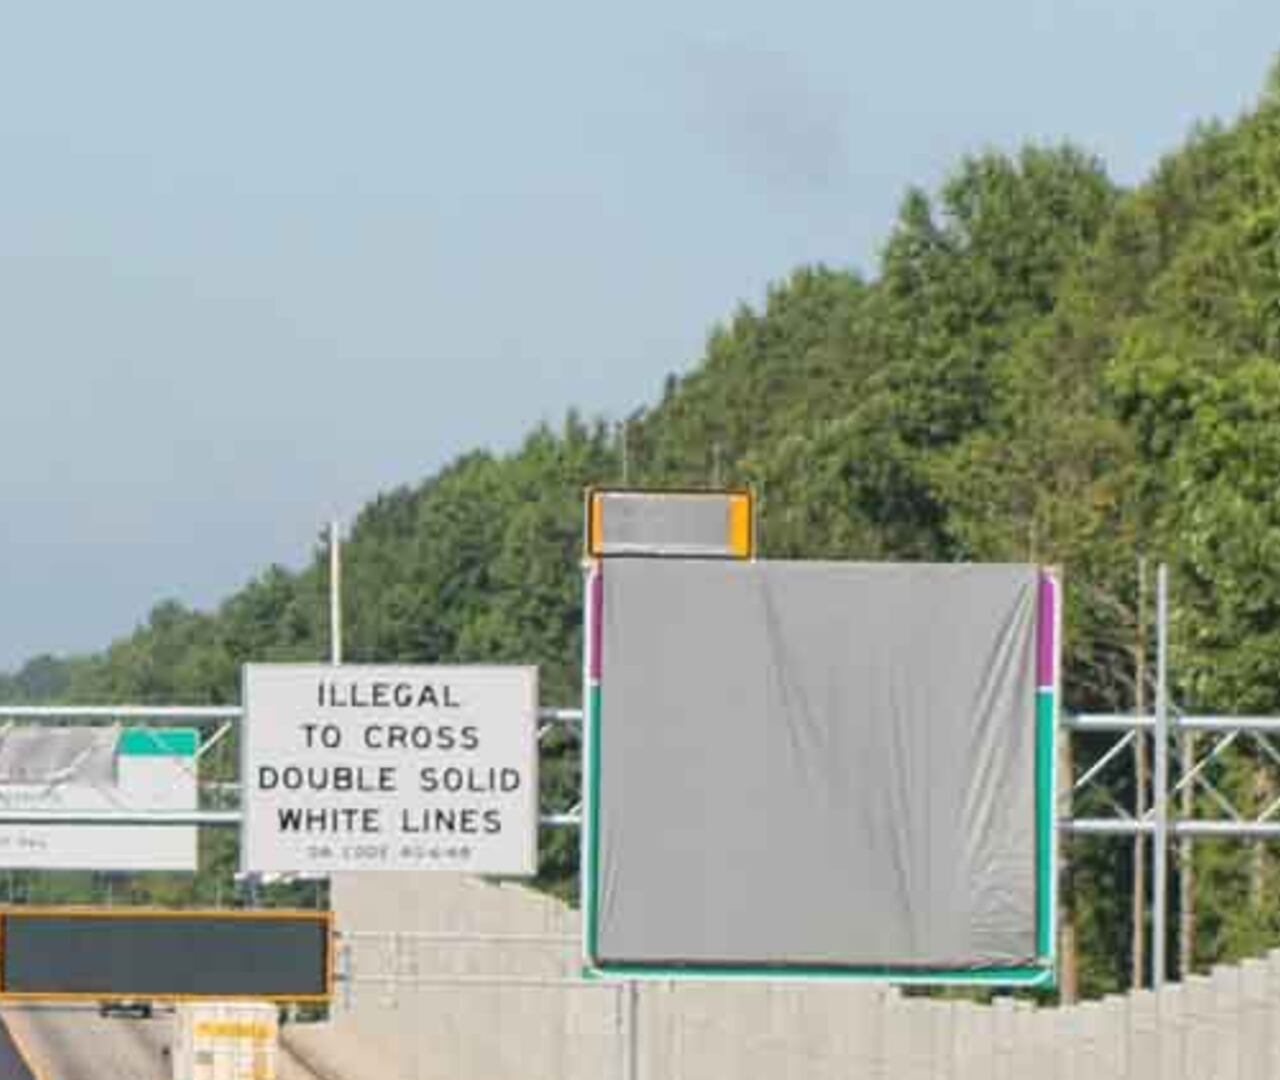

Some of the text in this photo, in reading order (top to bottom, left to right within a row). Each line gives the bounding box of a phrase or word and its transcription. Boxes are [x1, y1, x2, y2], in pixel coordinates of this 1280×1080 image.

[317, 682, 460, 708] ILLEGAL
[302, 723, 480, 750] TO CROSS
[258, 765, 521, 793] DOUBLE SOLID
[277, 807, 503, 834] WHITE LINES
